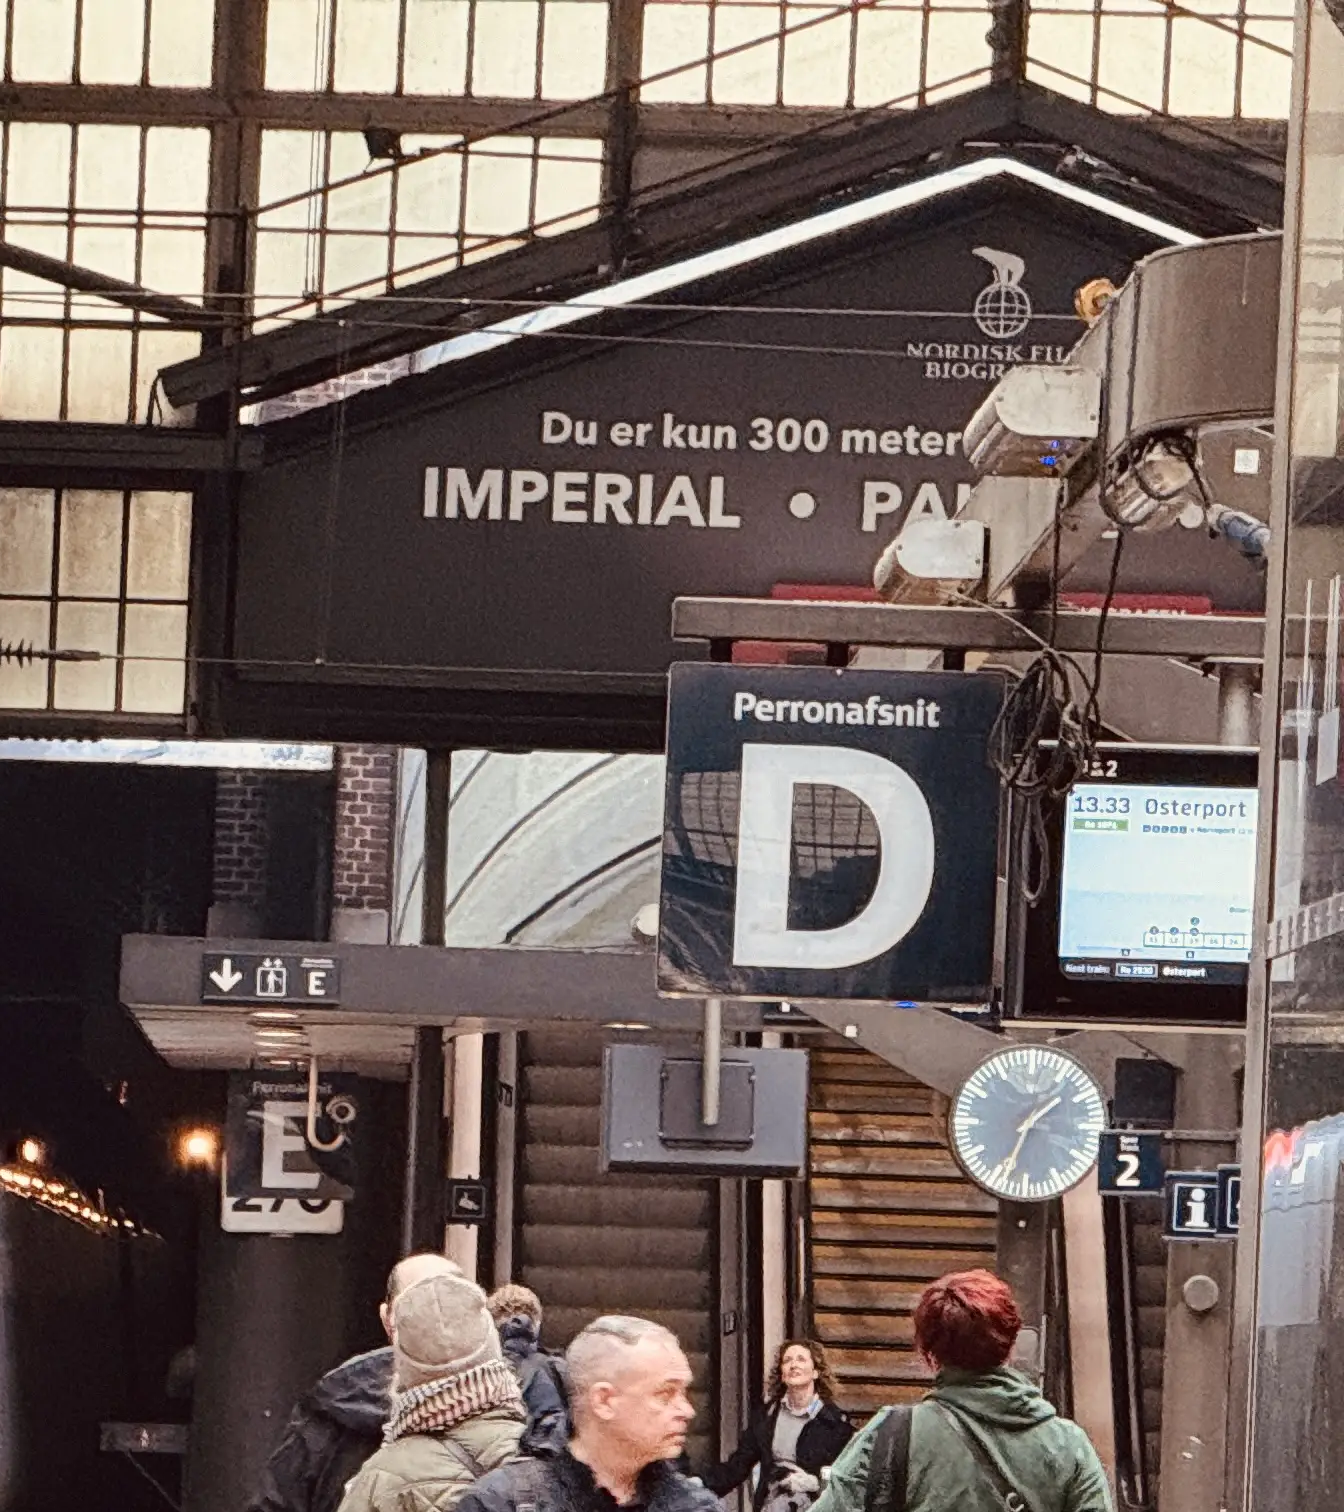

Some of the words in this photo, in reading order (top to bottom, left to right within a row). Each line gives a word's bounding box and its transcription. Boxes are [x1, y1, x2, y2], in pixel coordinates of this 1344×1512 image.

[907, 343, 1023, 361] NORDISK
[541, 411, 598, 446] Du
[610, 421, 653, 447] er
[663, 412, 737, 450] kun
[748, 417, 829, 453] 300
[840, 425, 963, 456] meter
[422, 467, 741, 529] IMPERIAL
[733, 692, 941, 728] Perronafsnit
[1073, 796, 1131, 814] 13.33
[732, 742, 935, 970] D
[308, 971, 327, 996] E
[261, 1100, 322, 1189] E
[1116, 1154, 1141, 1187] 2
